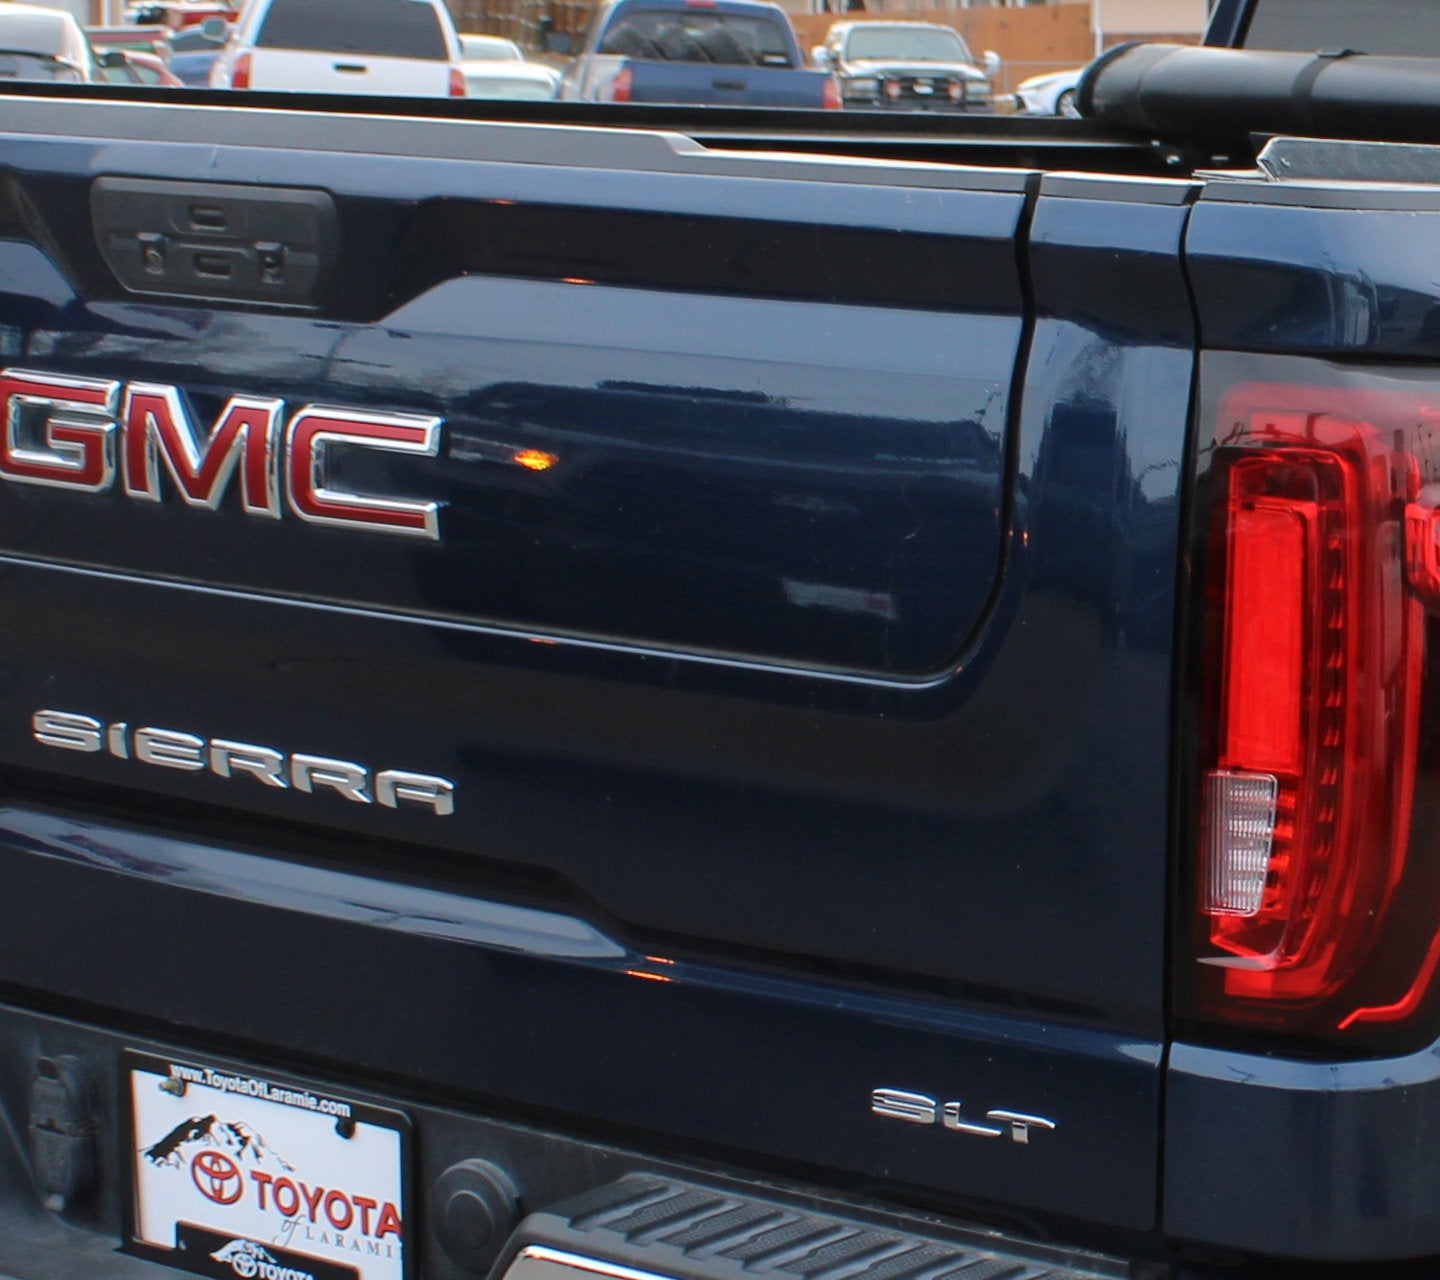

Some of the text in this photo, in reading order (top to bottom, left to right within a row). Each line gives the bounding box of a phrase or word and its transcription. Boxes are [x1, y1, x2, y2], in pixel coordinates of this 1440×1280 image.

[32, 709, 455, 816] SIERRA
[171, 1064, 351, 1118] www.ToyotaOfLaramie.com
[871, 1087, 1056, 1144] SLT
[250, 1169, 403, 1239] TOYOTA
[304, 1226, 405, 1261] LARAMI
